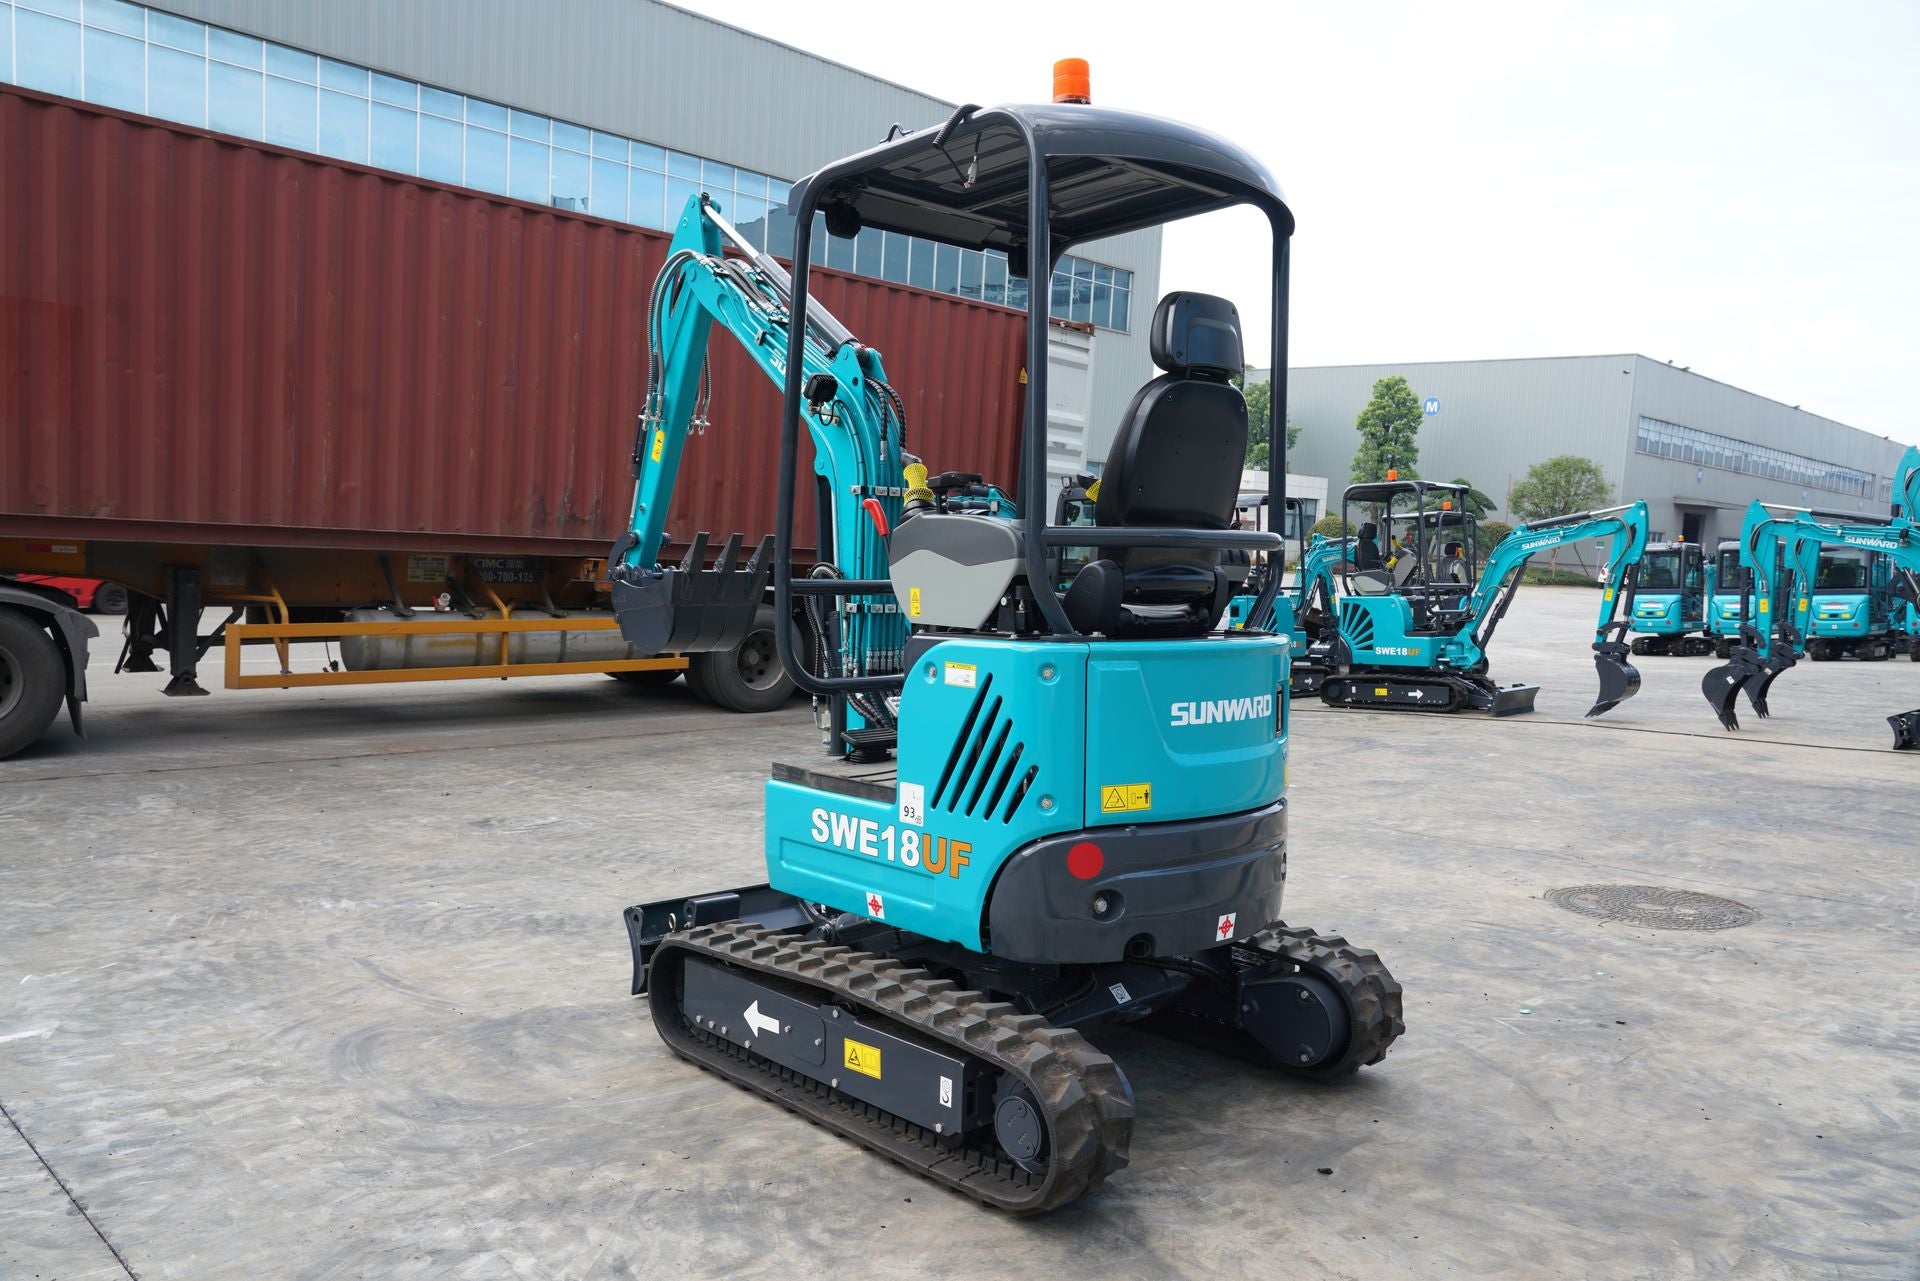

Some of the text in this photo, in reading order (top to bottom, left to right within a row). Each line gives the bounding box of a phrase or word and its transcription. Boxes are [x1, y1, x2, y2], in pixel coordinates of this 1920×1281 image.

[1426, 401, 1438, 412] M
[1521, 536, 1561, 550] SUNWARD
[1844, 536, 1898, 549] SUNWARD
[473, 558, 504, 569] CIMC
[1375, 646, 1421, 656] SWE18UF
[1170, 694, 1272, 726] SUNWARD
[903, 805, 923, 824] 93 dB
[810, 807, 973, 880] SWE18UF
